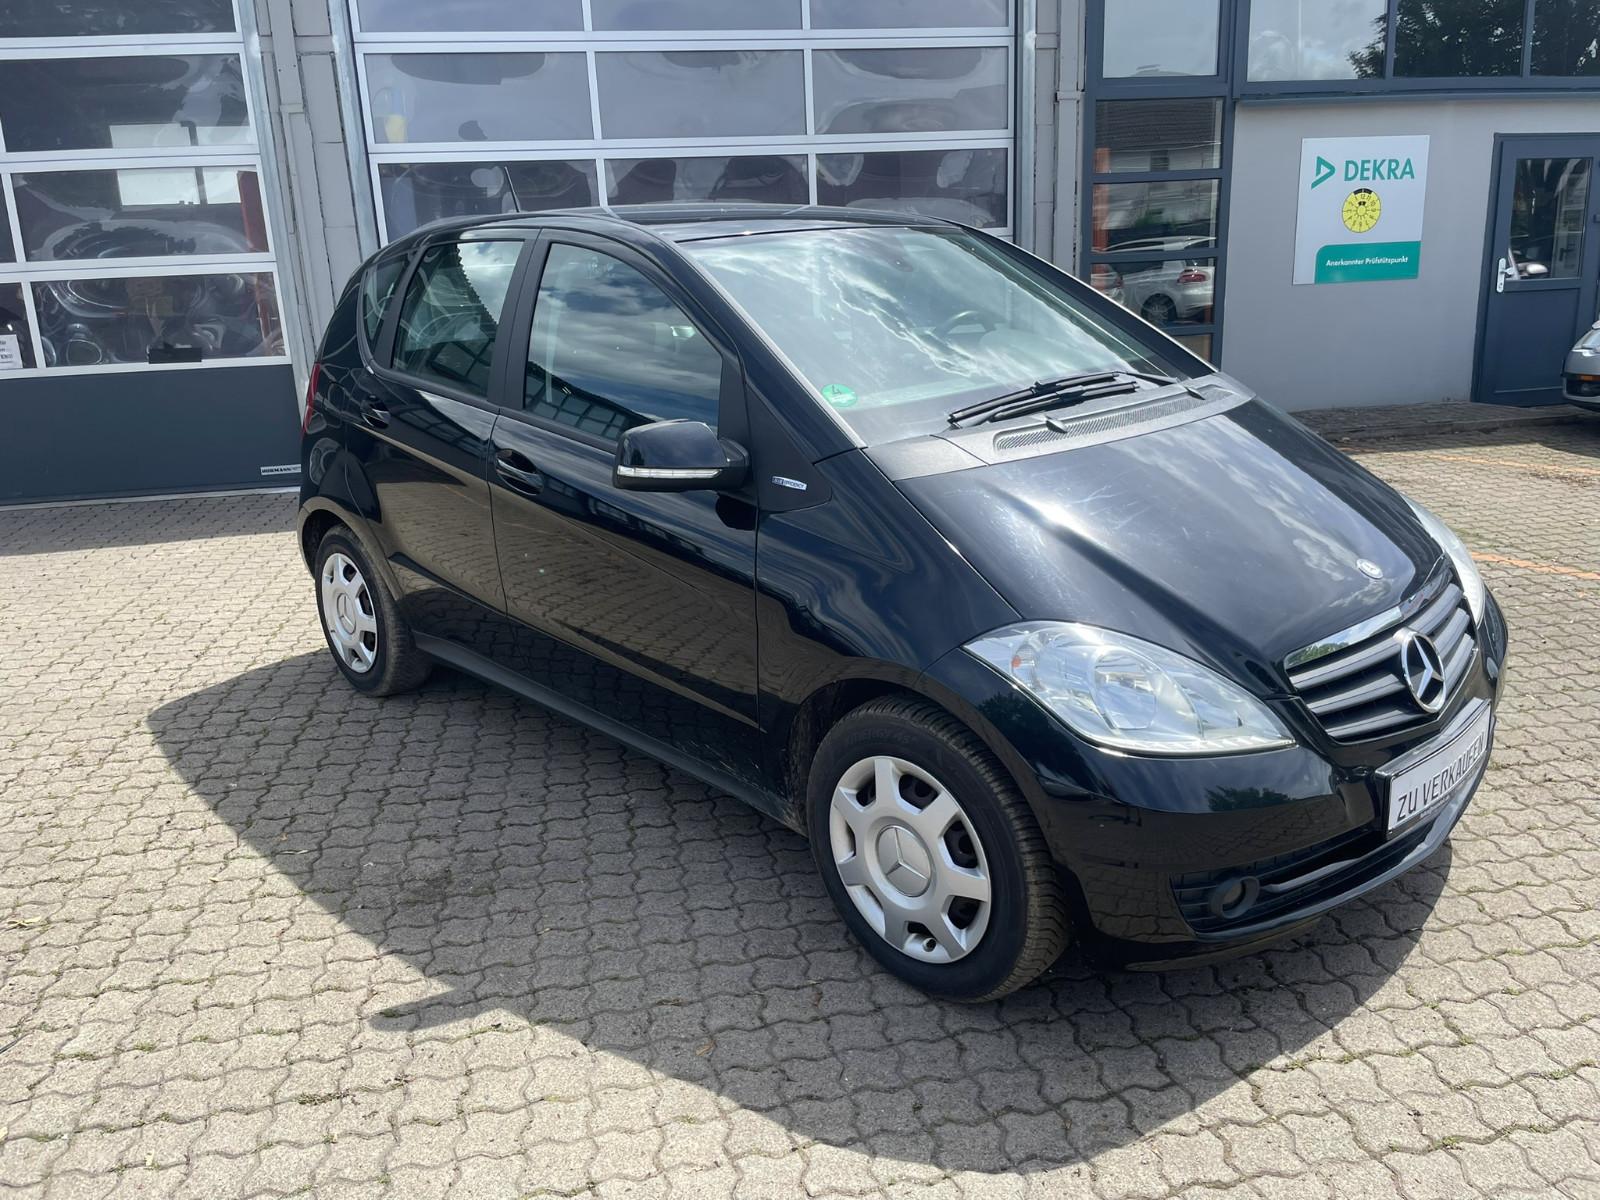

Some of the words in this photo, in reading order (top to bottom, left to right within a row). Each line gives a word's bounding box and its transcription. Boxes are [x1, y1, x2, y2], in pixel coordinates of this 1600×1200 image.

[1344, 157, 1415, 181] DEKRA
[1326, 258, 1364, 267] Anerkannter
[1397, 787, 1418, 822] ZU
[1423, 731, 1485, 806] VERKAUFEN
